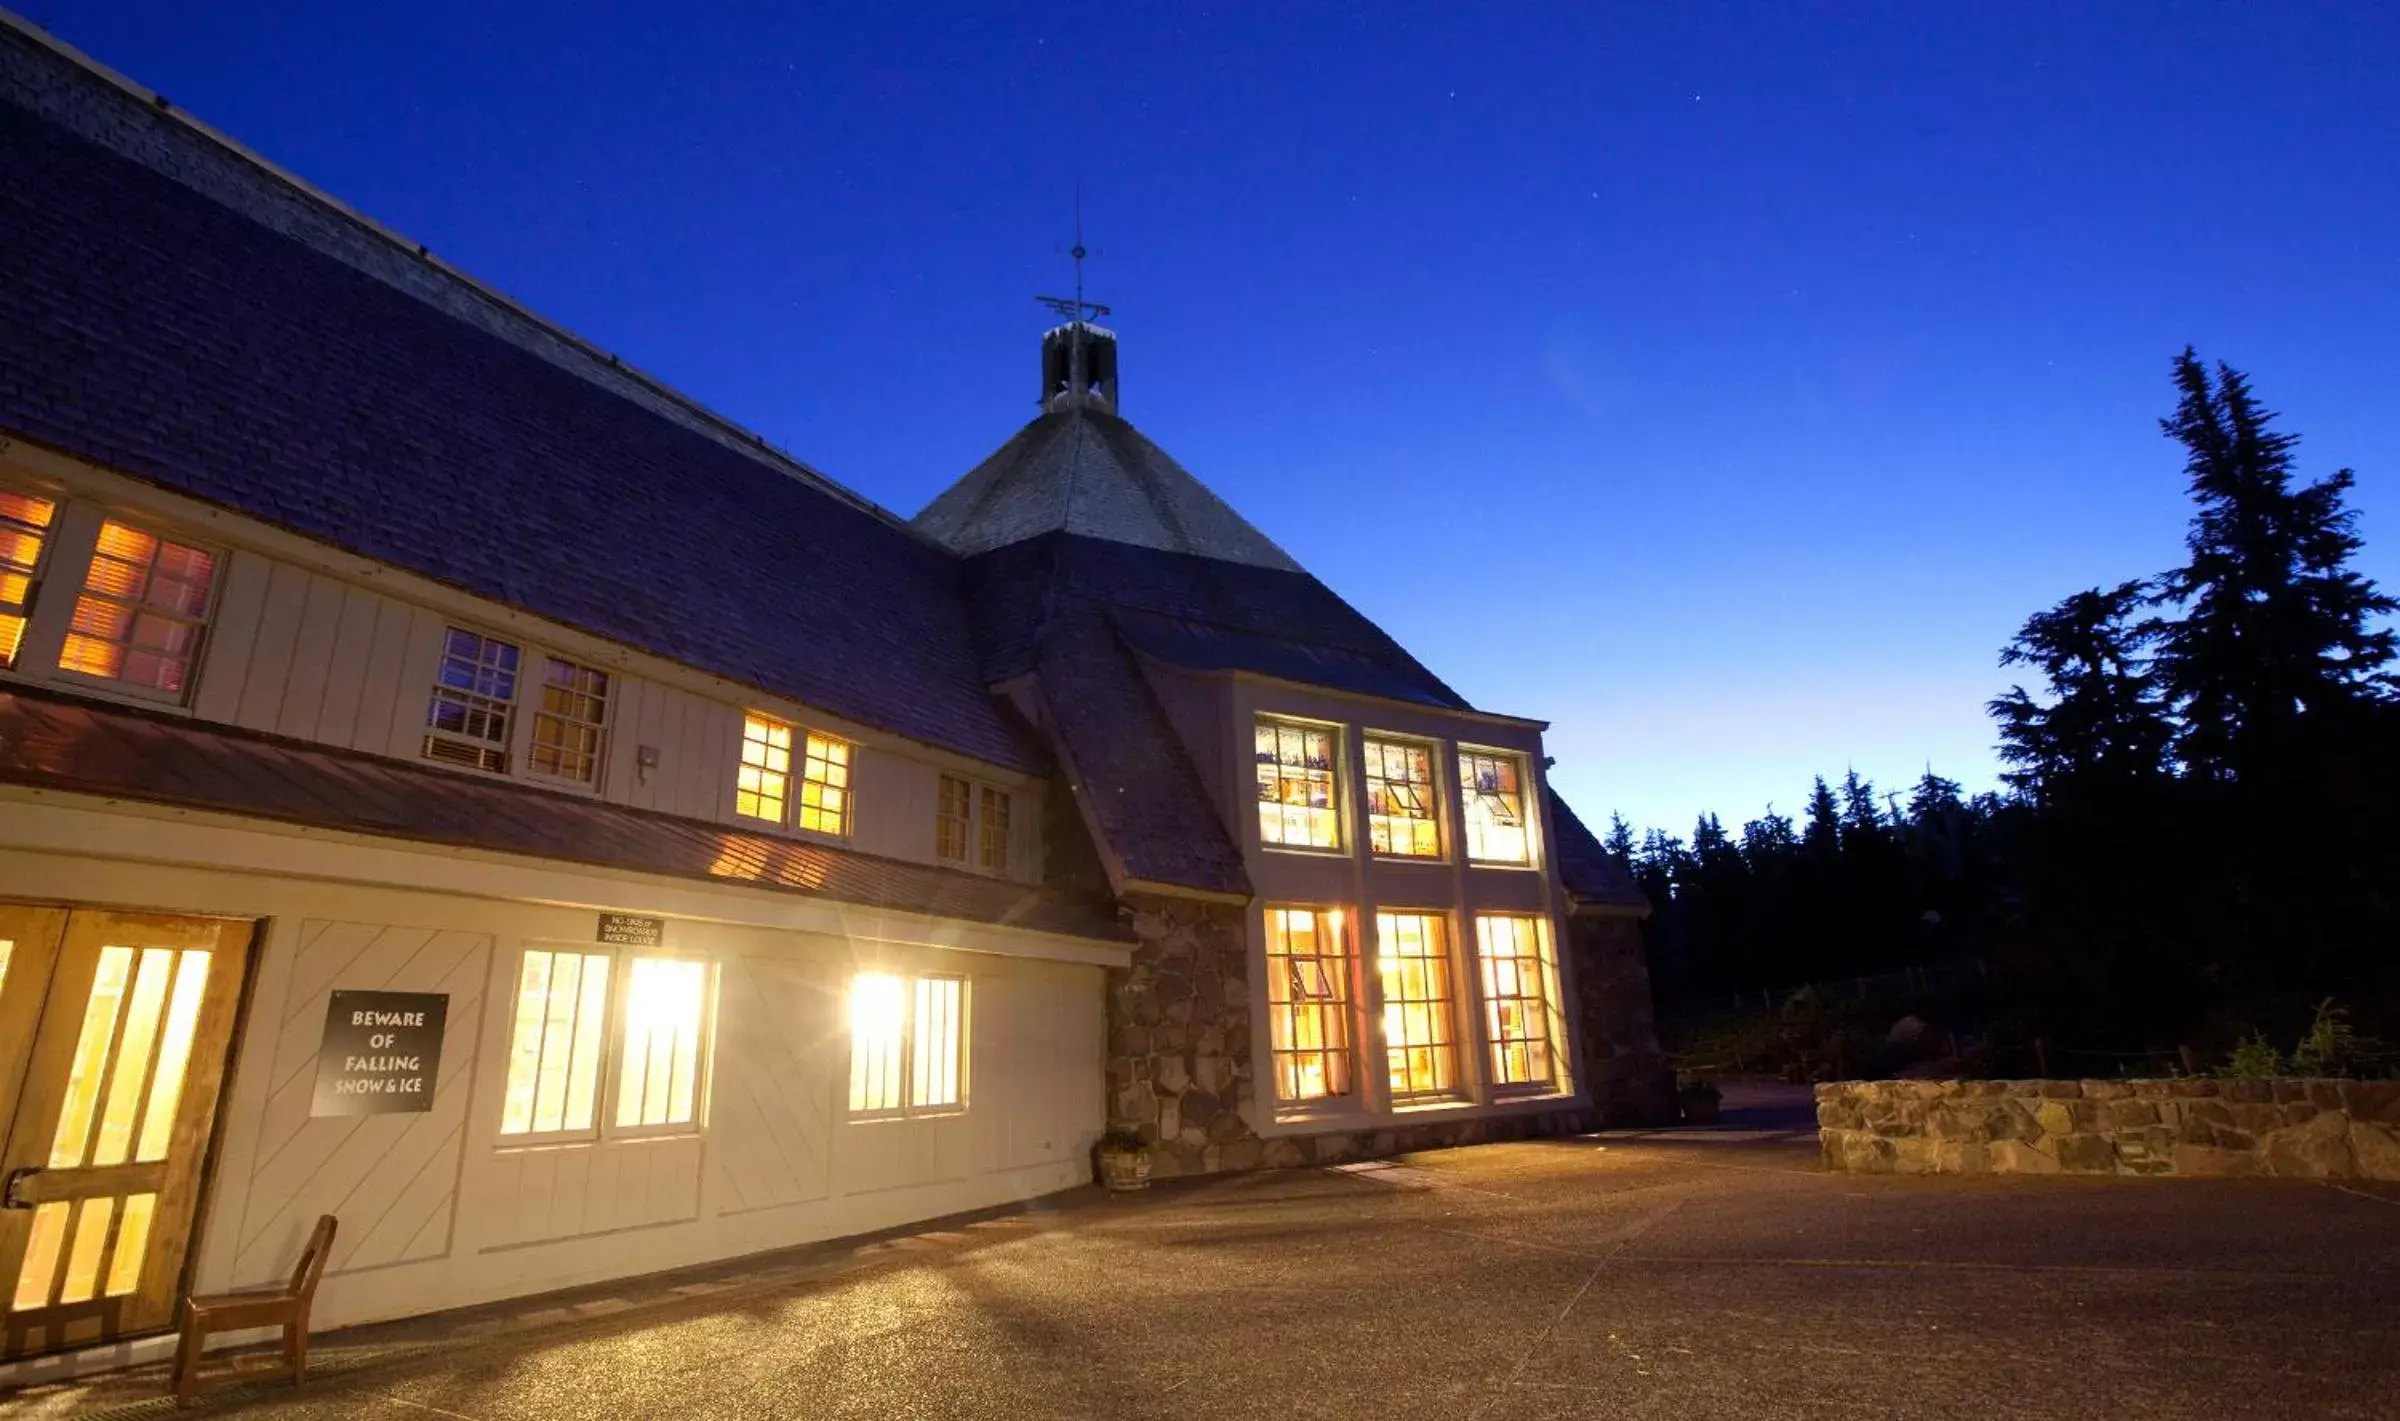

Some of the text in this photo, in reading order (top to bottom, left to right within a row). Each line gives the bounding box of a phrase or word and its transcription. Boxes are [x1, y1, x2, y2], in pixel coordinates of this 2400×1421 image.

[351, 1011, 425, 1027] BEWARE
[370, 1033, 395, 1049] OF
[344, 1056, 419, 1072] FALLING
[335, 1078, 422, 1094] SNOW & ICE
